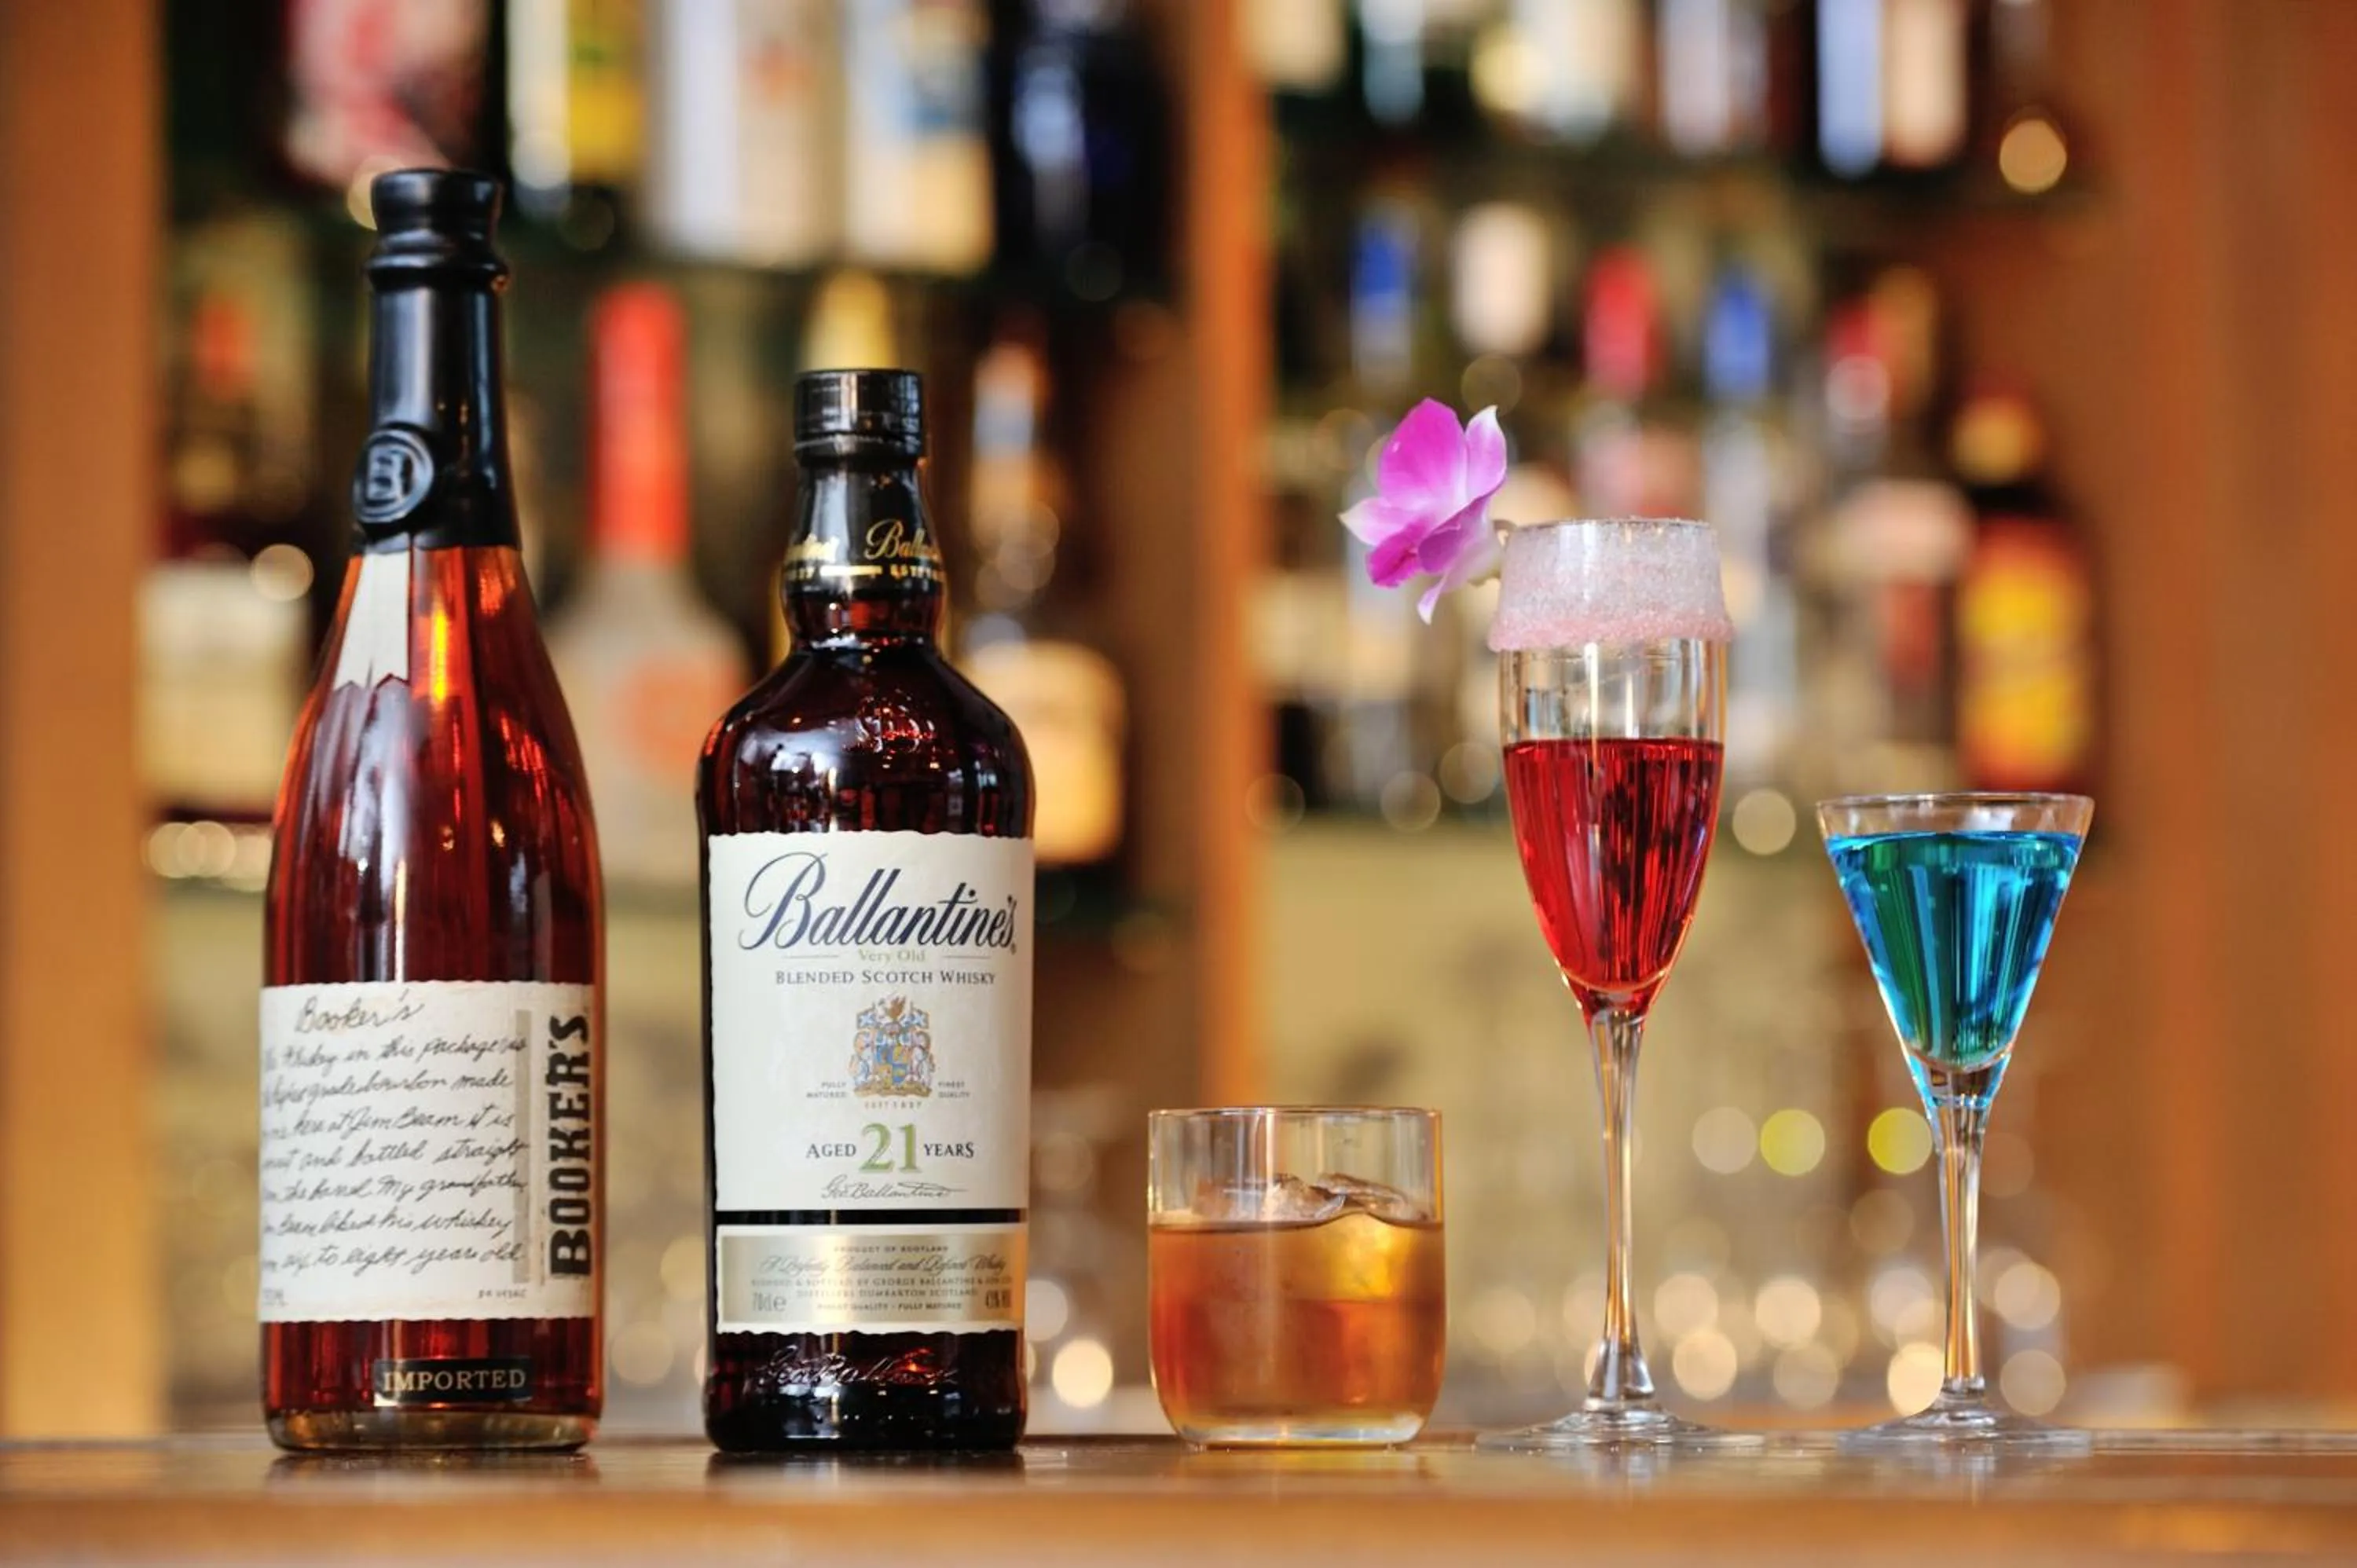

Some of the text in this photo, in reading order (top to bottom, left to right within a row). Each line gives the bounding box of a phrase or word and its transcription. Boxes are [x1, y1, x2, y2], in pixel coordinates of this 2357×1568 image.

[738, 851, 1017, 950] Ballantine's
[859, 948, 926, 964] Very Old
[775, 970, 995, 985] BLENDED SCOTCH WHISKY
[294, 988, 425, 1034] Booker's
[546, 1016, 591, 1277] BOOKER'S
[805, 1123, 975, 1174] AGED 21 YEARS
[872, 1277, 915, 1286] GEORGE
[383, 1369, 526, 1392] IMPORTED
